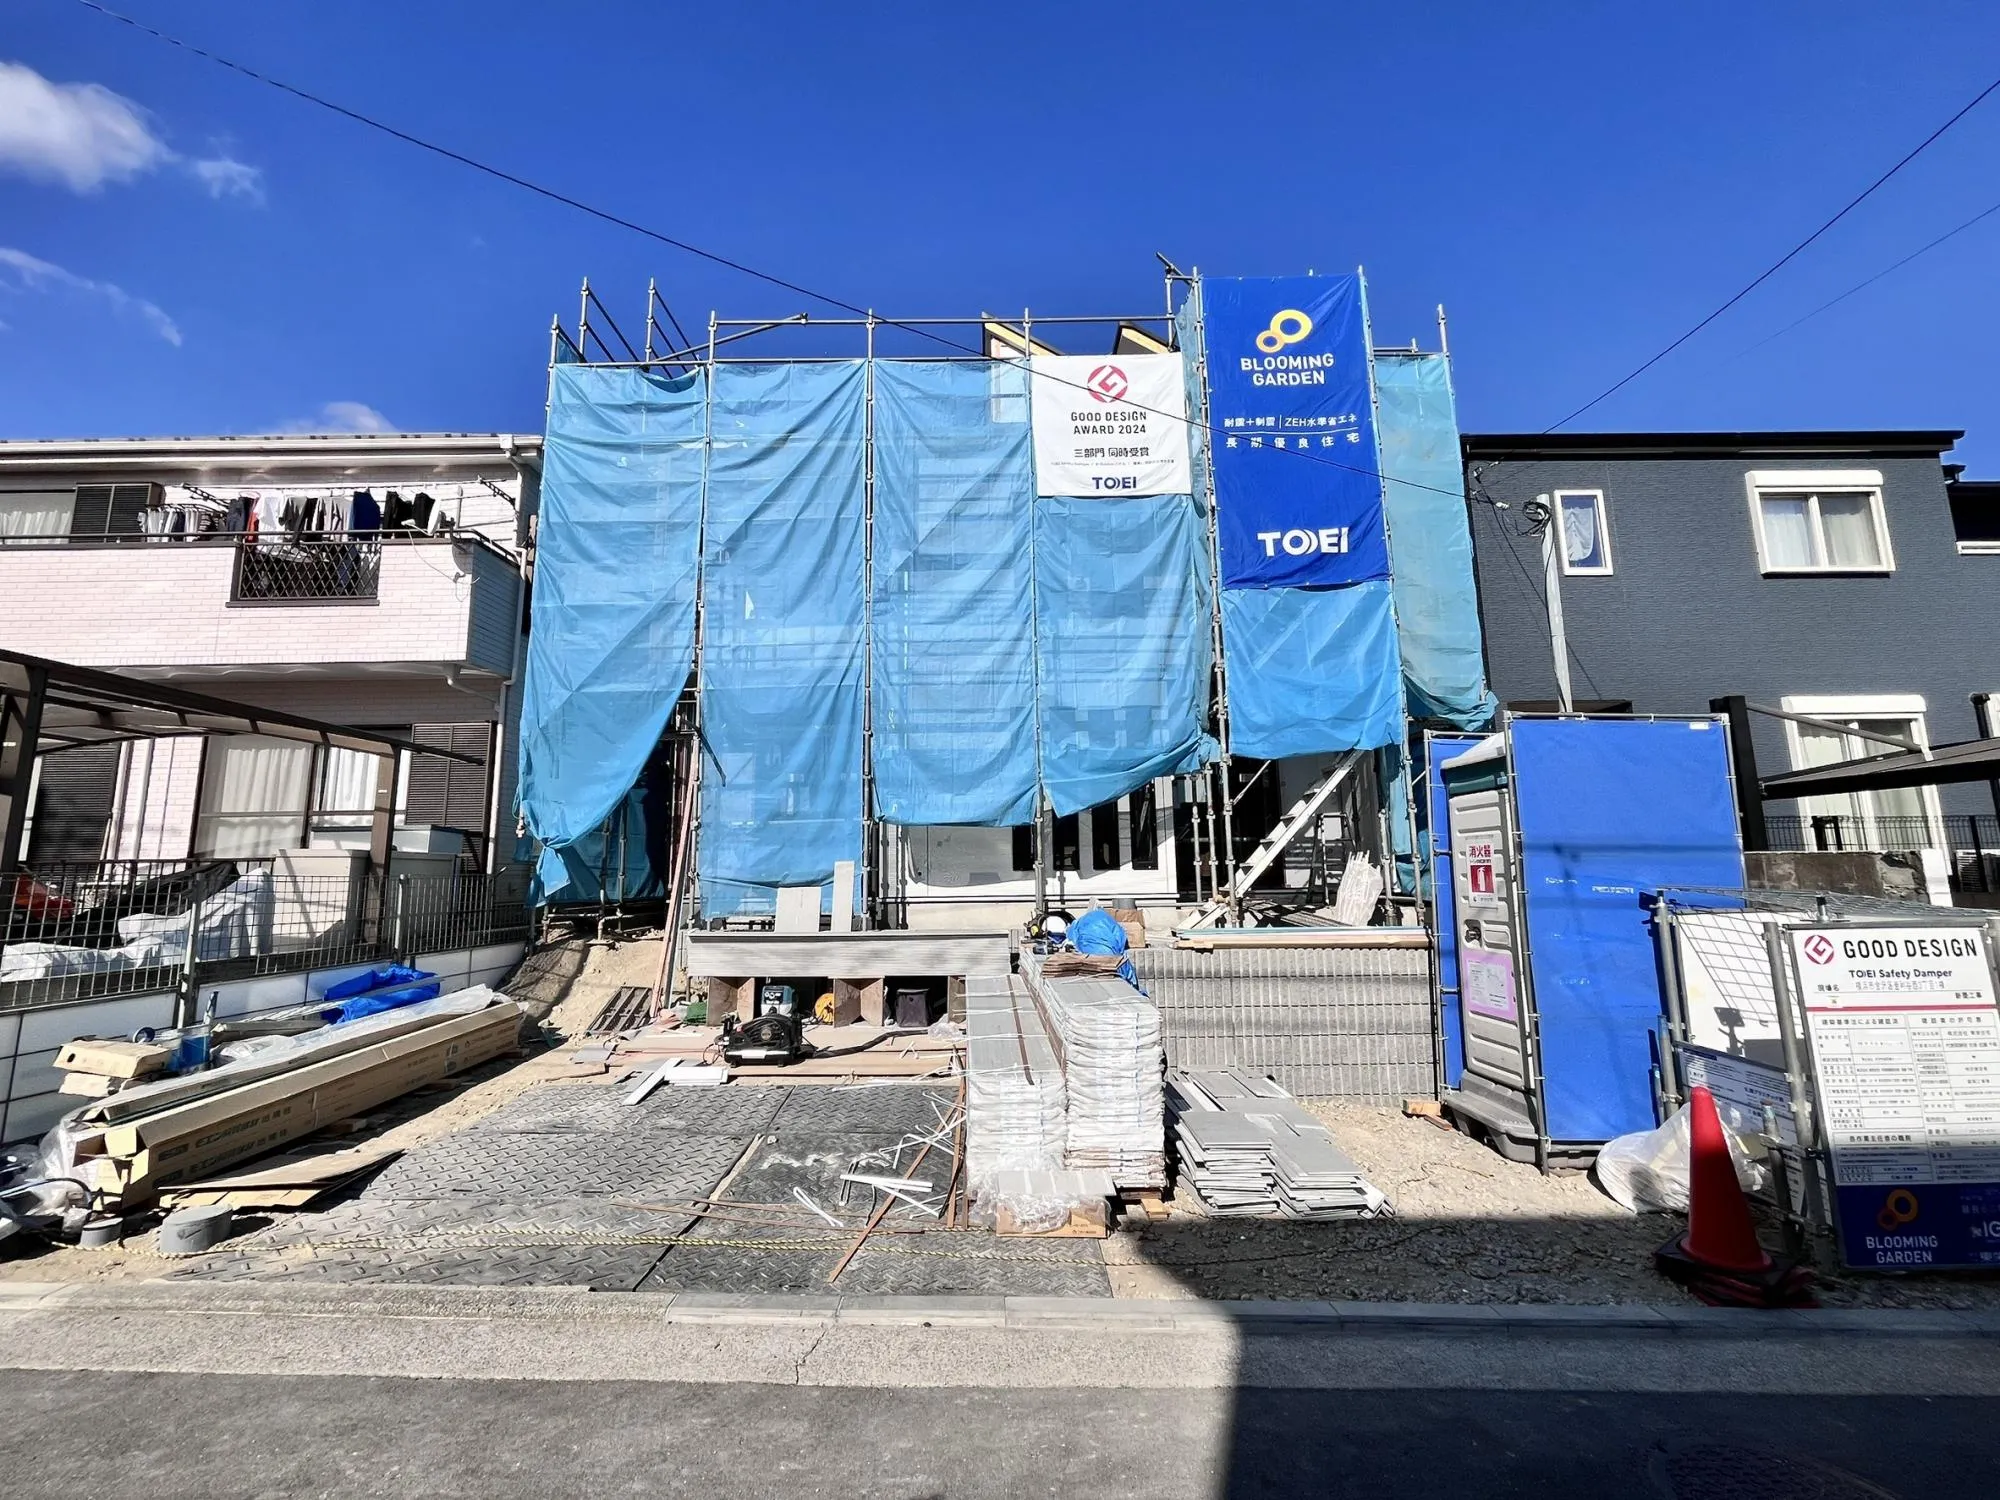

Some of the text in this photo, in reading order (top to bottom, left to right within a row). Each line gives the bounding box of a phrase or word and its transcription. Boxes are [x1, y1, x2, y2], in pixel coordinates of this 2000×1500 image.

[1240, 353, 1335, 371] BLOOMING
[1252, 370, 1325, 386] GARDEN
[1071, 411, 1147, 422] GOOD DESIGN
[1284, 413, 1357, 428] ZEH水準省エネ
[1073, 424, 1146, 435] AWARD 2024
[1074, 447, 1150, 458] 三部門 同時受賞
[1092, 476, 1137, 490] TOEI
[1257, 527, 1349, 557] TOEI
[1469, 844, 1491, 858] 消火器
[1843, 938, 1977, 958] GOOD DESIGN
[1879, 969, 1911, 980] Safety
[1913, 969, 1953, 979] Damper
[1865, 1235, 1938, 1249] BLOOMING
[1876, 1250, 1933, 1264] GARDEN
